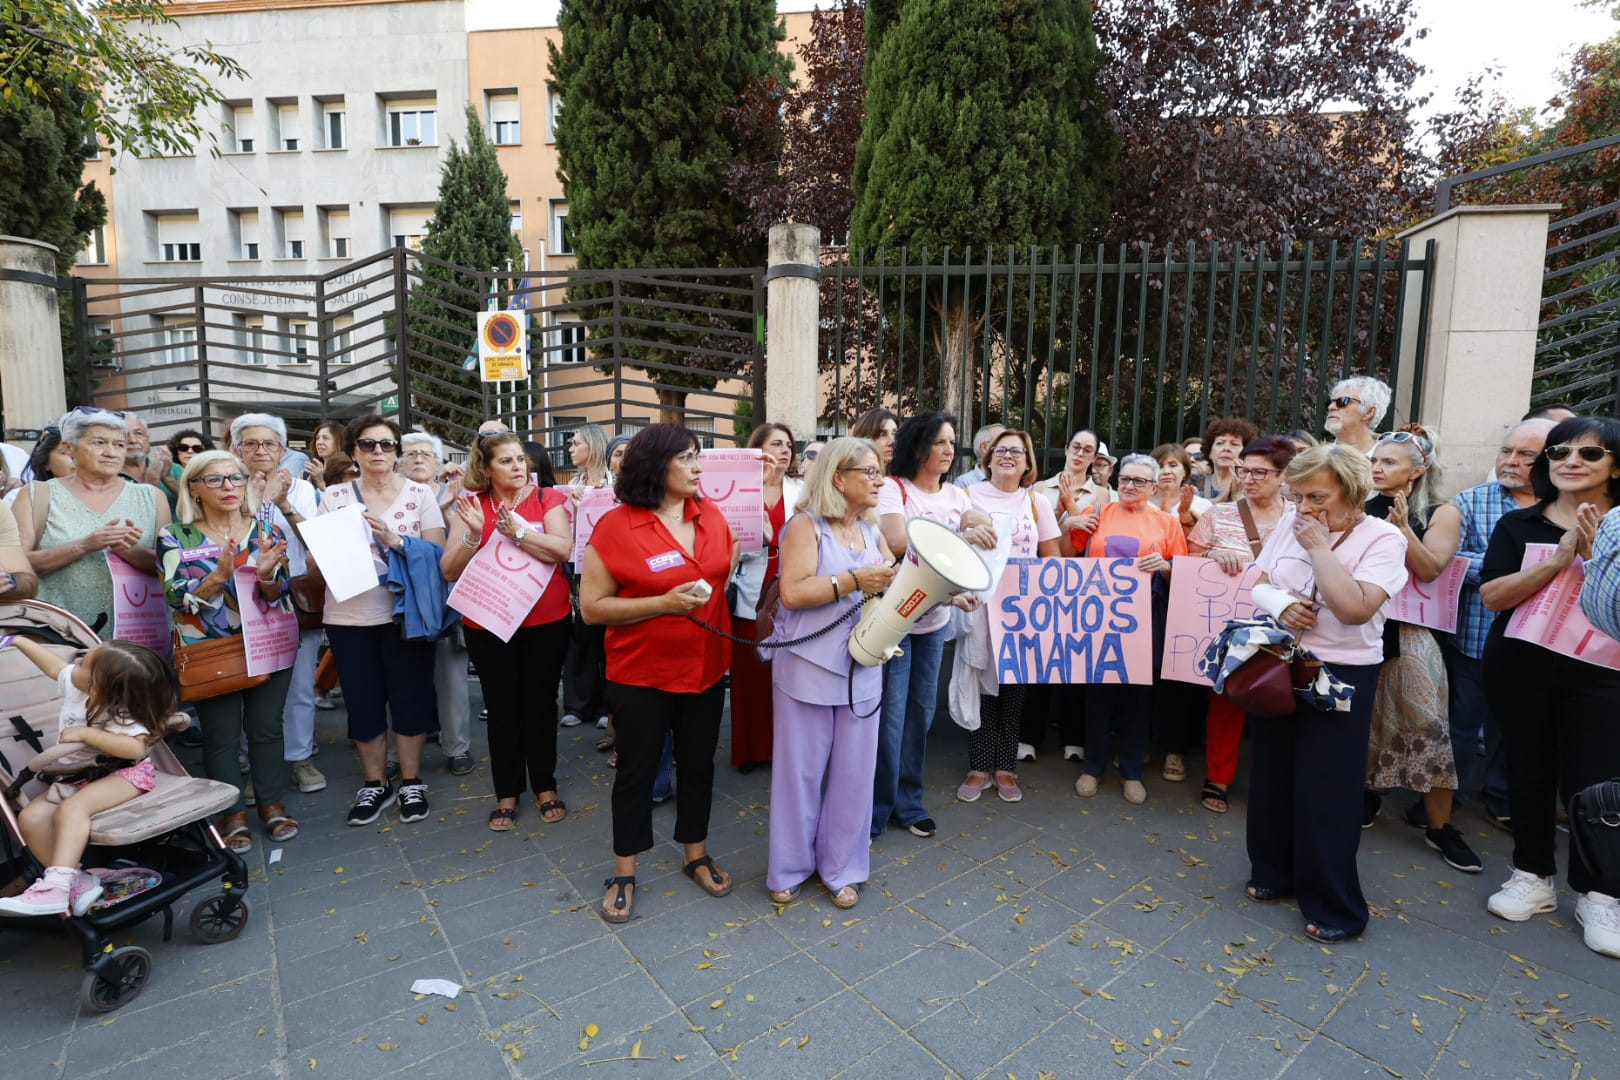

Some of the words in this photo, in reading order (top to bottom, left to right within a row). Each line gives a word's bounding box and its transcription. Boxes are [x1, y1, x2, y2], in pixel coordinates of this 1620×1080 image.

[1006, 557, 1139, 597] TODAS
[1001, 595, 1138, 633] SOMOS
[999, 633, 1130, 685] AMAMA
